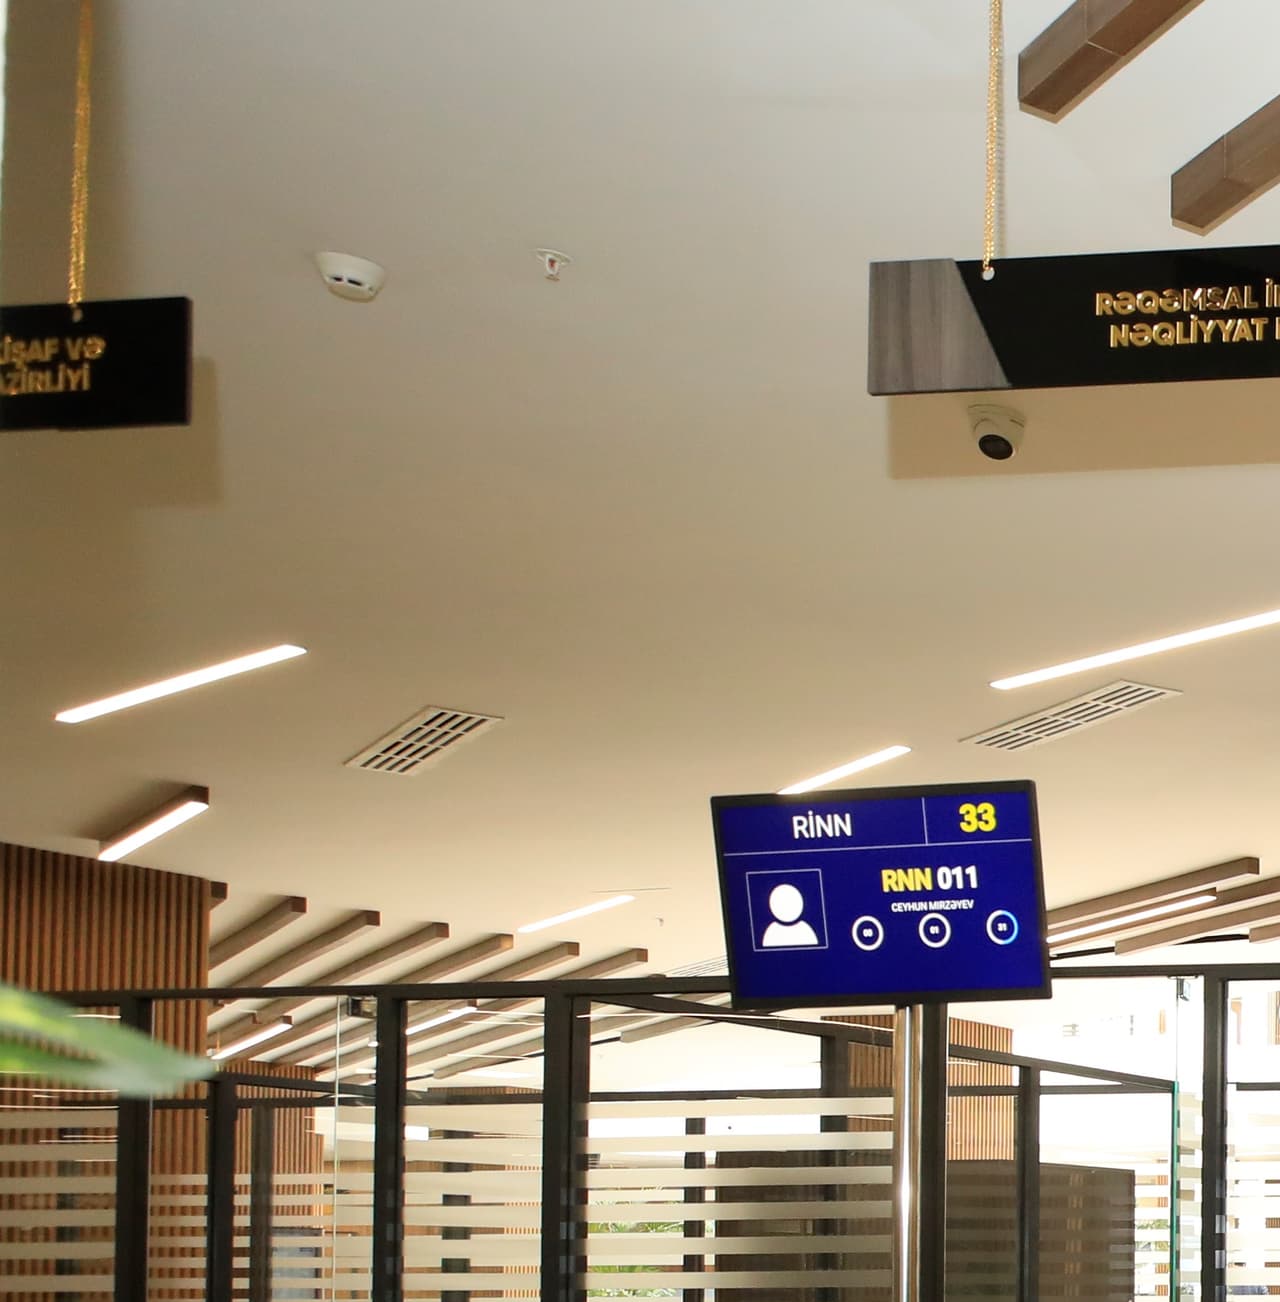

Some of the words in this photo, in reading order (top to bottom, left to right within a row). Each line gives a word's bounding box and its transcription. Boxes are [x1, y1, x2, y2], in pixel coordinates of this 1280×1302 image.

[1095, 285, 1259, 315] RƏQƏMSAL
[1109, 314, 1268, 348] NƏQLİYYAT
[0, 333, 59, 369] İŞAF
[65, 335, 106, 361] VƏ
[792, 810, 852, 839] RİNN
[958, 802, 997, 833] 33
[881, 867, 933, 893] RNN
[937, 865, 978, 890] 011
[891, 901, 928, 913] CEYHUN
